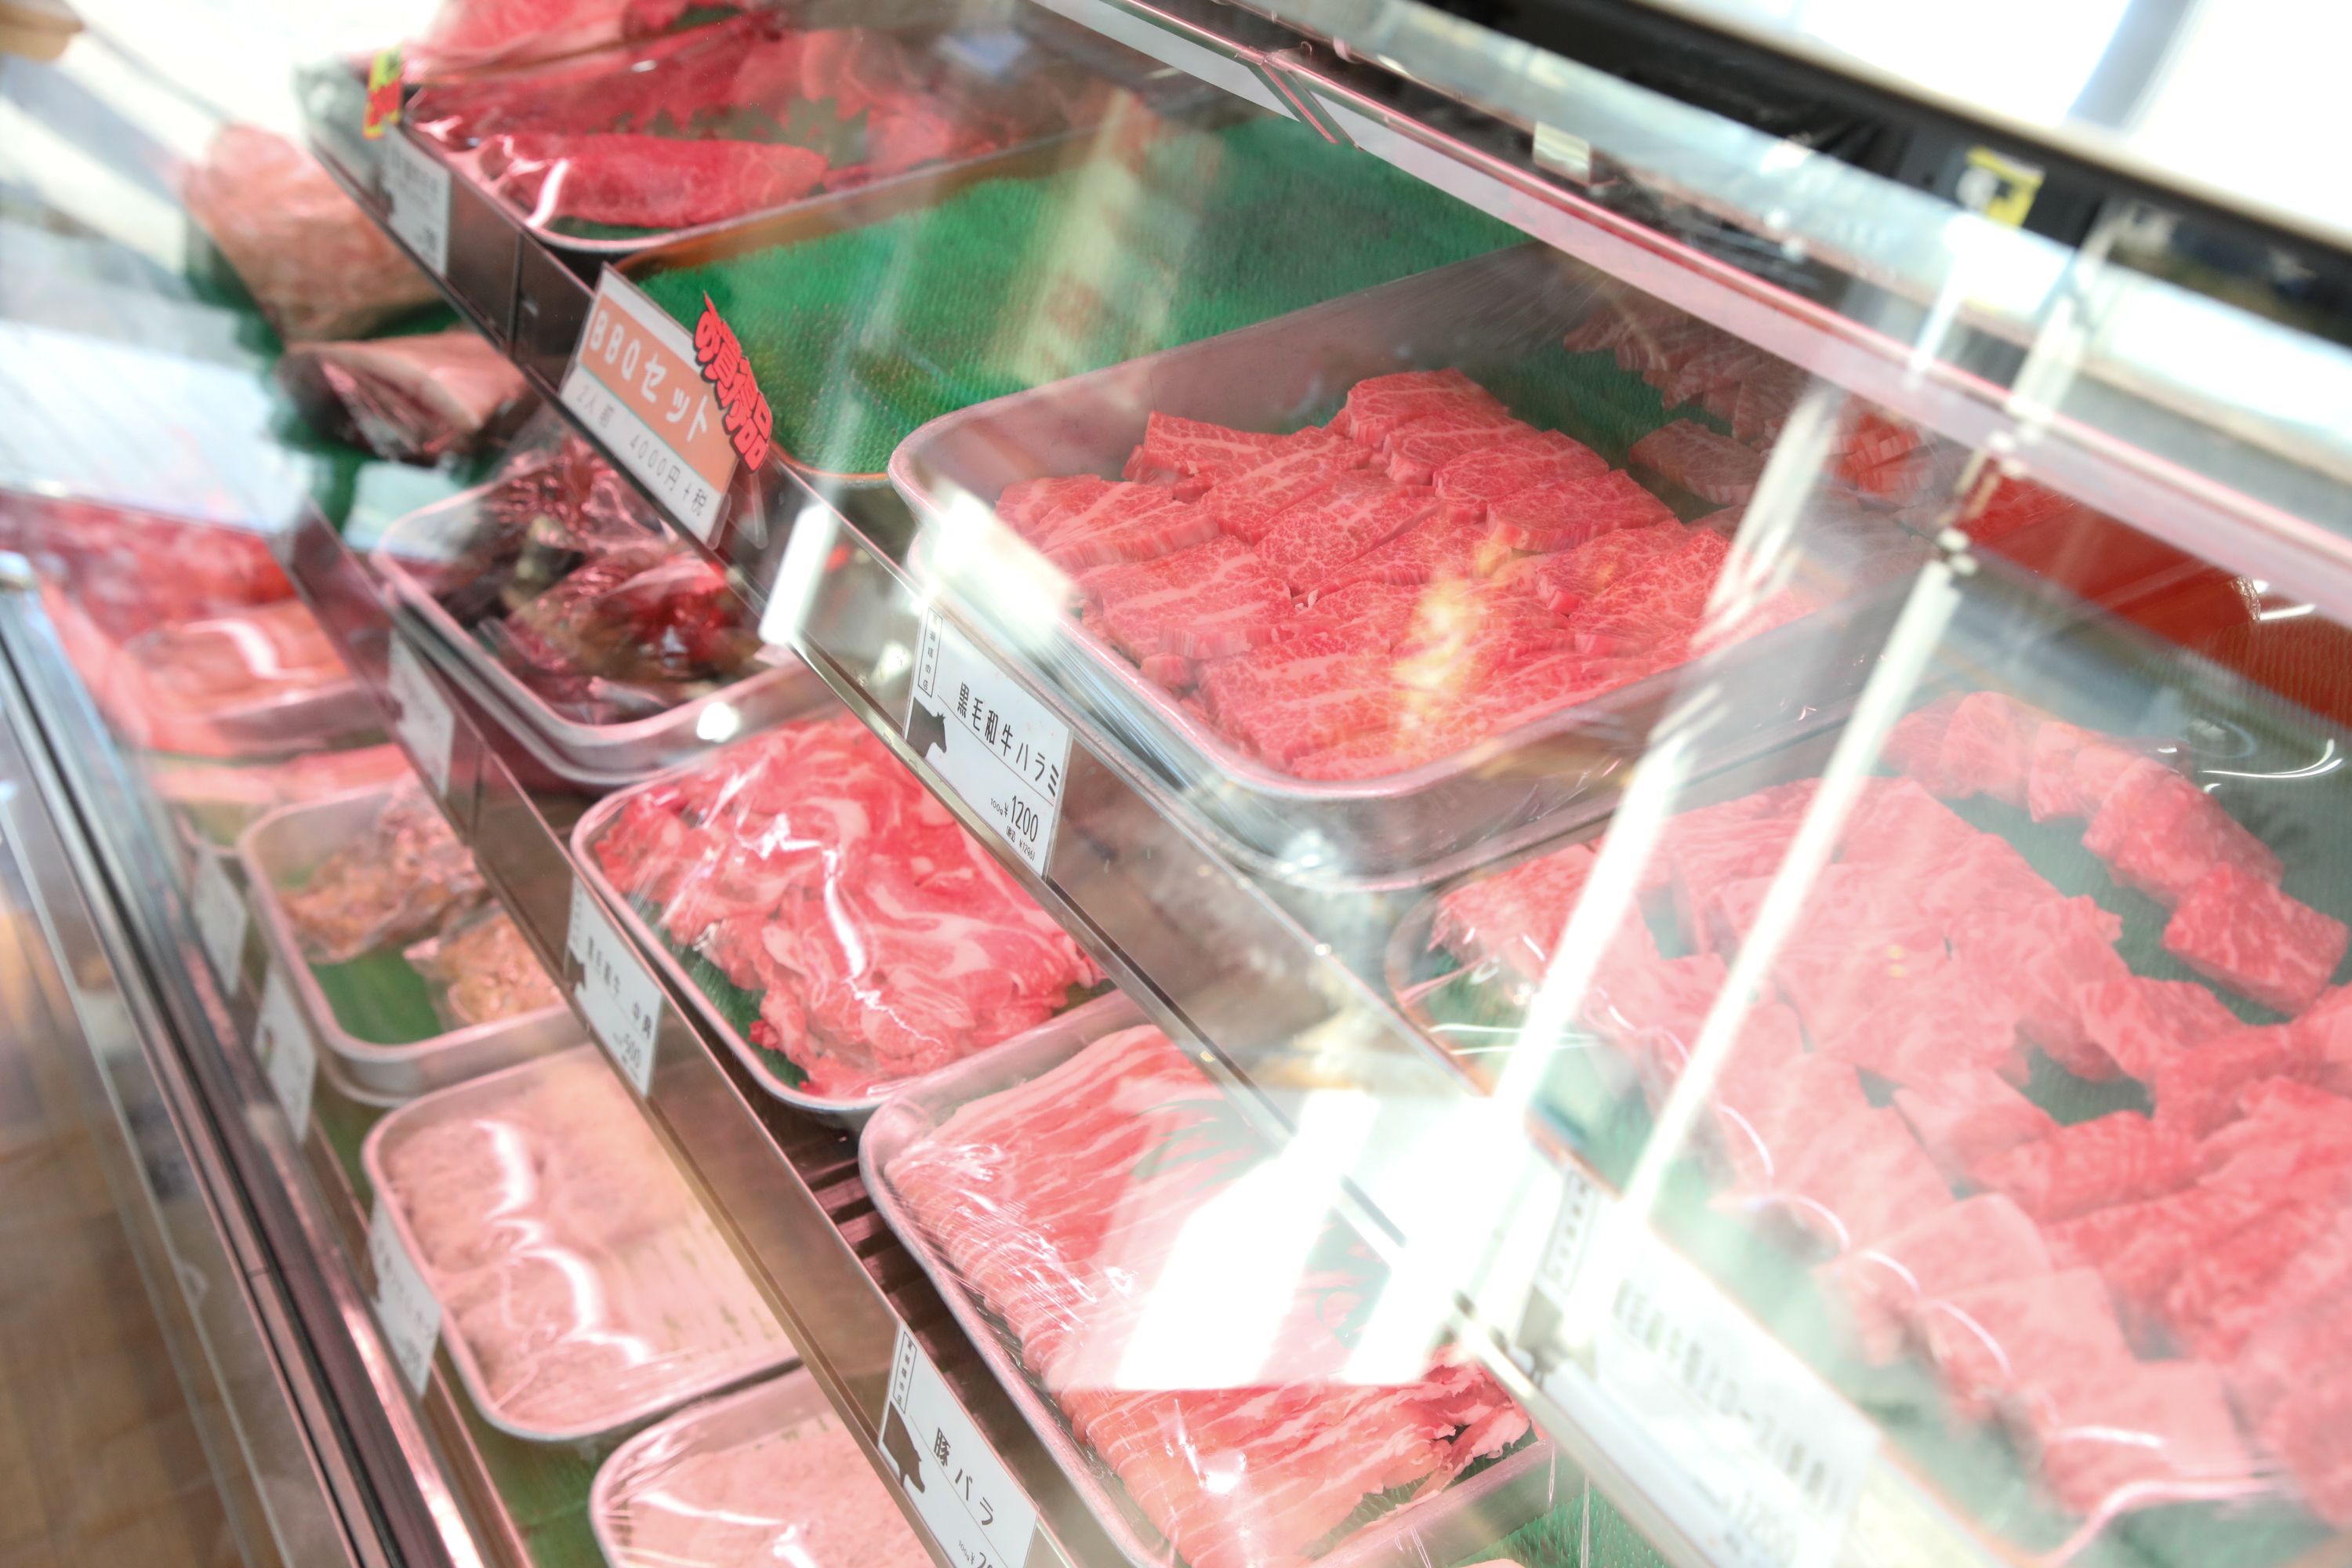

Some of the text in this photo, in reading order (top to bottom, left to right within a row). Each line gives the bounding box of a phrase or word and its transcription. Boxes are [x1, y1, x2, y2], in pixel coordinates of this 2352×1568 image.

[956, 681, 1059, 798] 黒毛和牛ハラミ
[934, 1427, 993, 1526] 豚バラ
